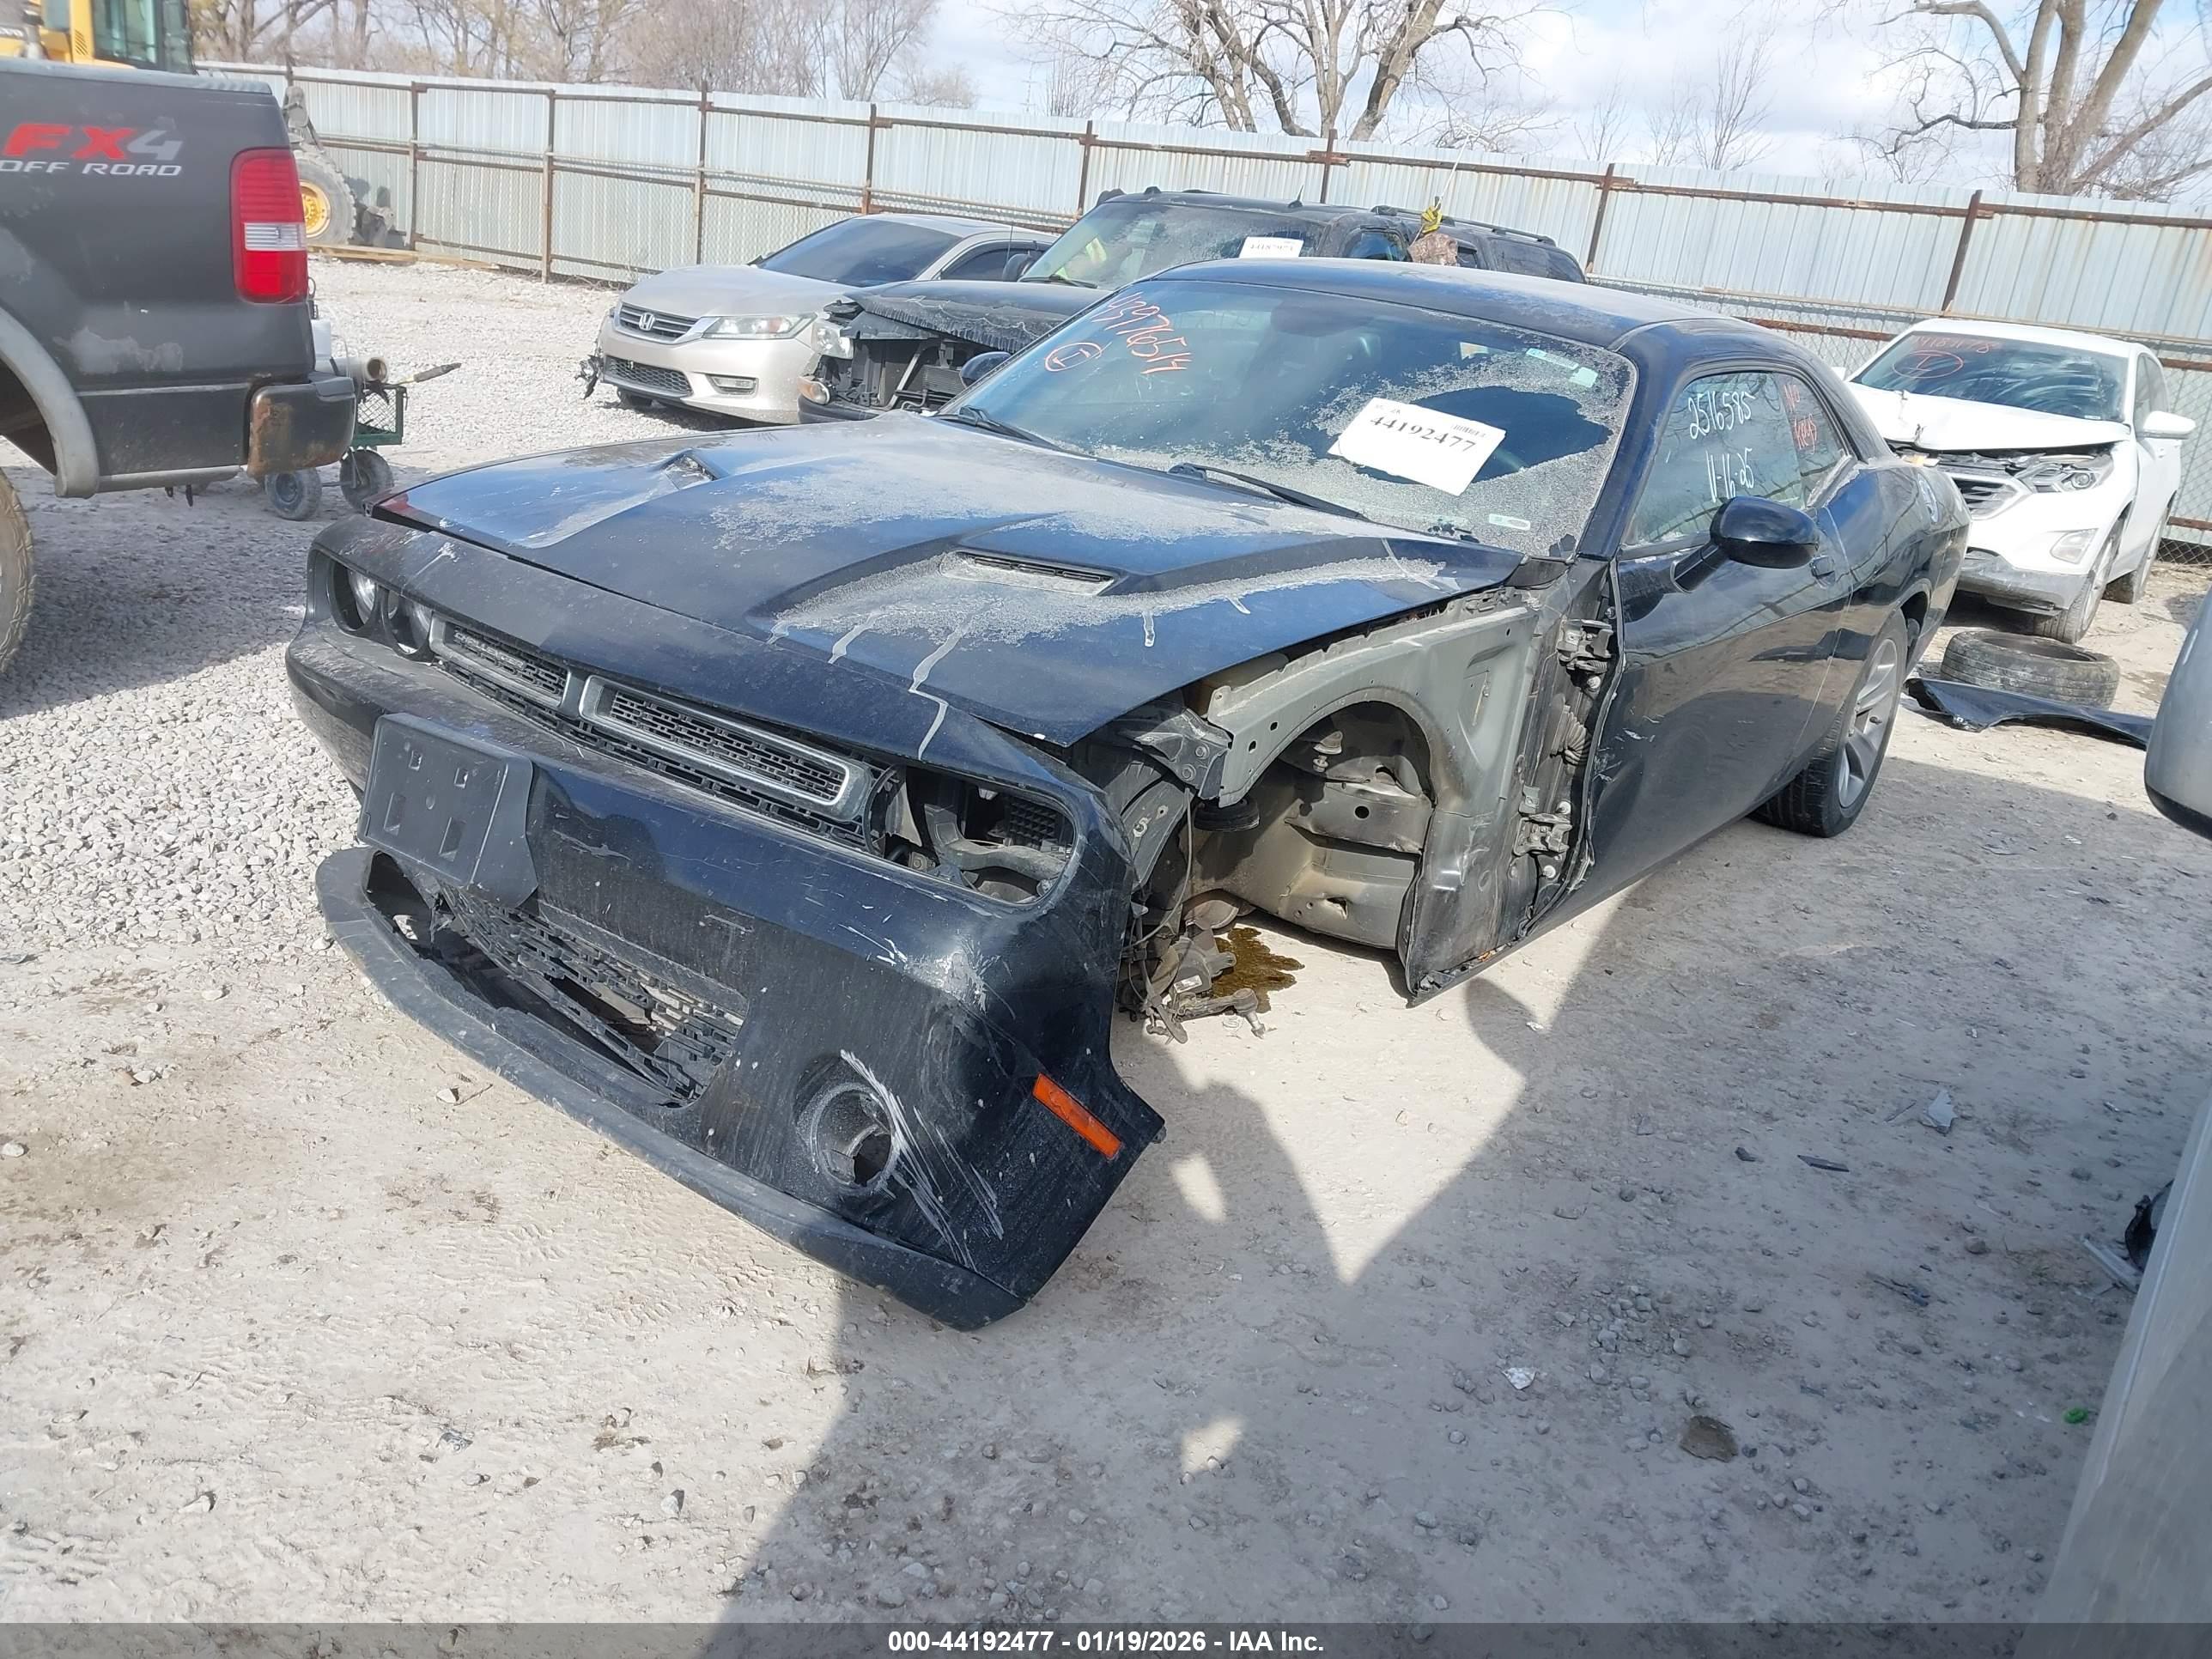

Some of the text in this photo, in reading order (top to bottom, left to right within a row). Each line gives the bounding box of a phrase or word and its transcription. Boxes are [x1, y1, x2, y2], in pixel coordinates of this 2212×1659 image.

[3, 123, 183, 161] FX4
[0, 160, 182, 176] OFF ROAD
[1687, 390, 1756, 440] 2516585
[1370, 416, 1476, 453] 44192477
